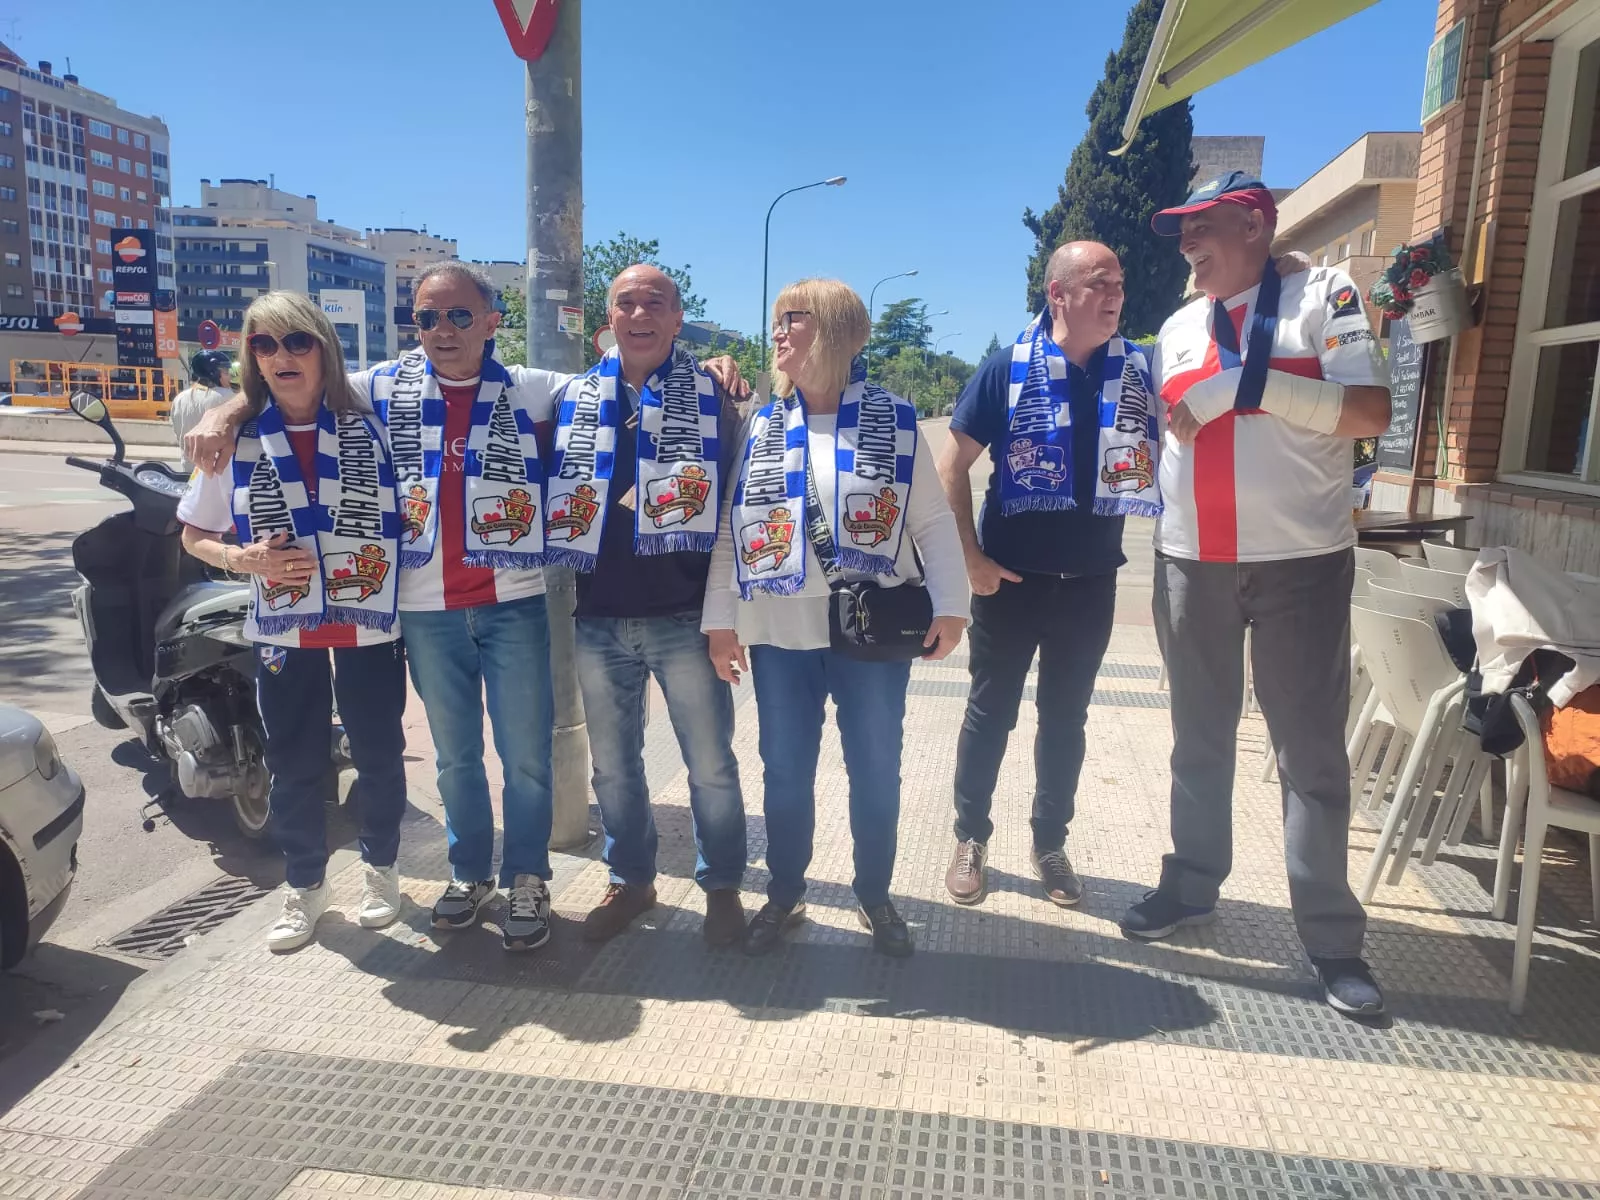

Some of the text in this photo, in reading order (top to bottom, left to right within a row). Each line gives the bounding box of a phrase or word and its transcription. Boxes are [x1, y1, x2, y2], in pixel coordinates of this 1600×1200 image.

[115, 265, 148, 274] REPSOL
[394, 367, 425, 387] DE
[389, 390, 423, 482] CORAZONES
[559, 390, 600, 482] CORAZONES
[650, 426, 704, 464] PEÑA
[478, 442, 528, 486] PEÑA
[330, 498, 382, 541] PEÑA
